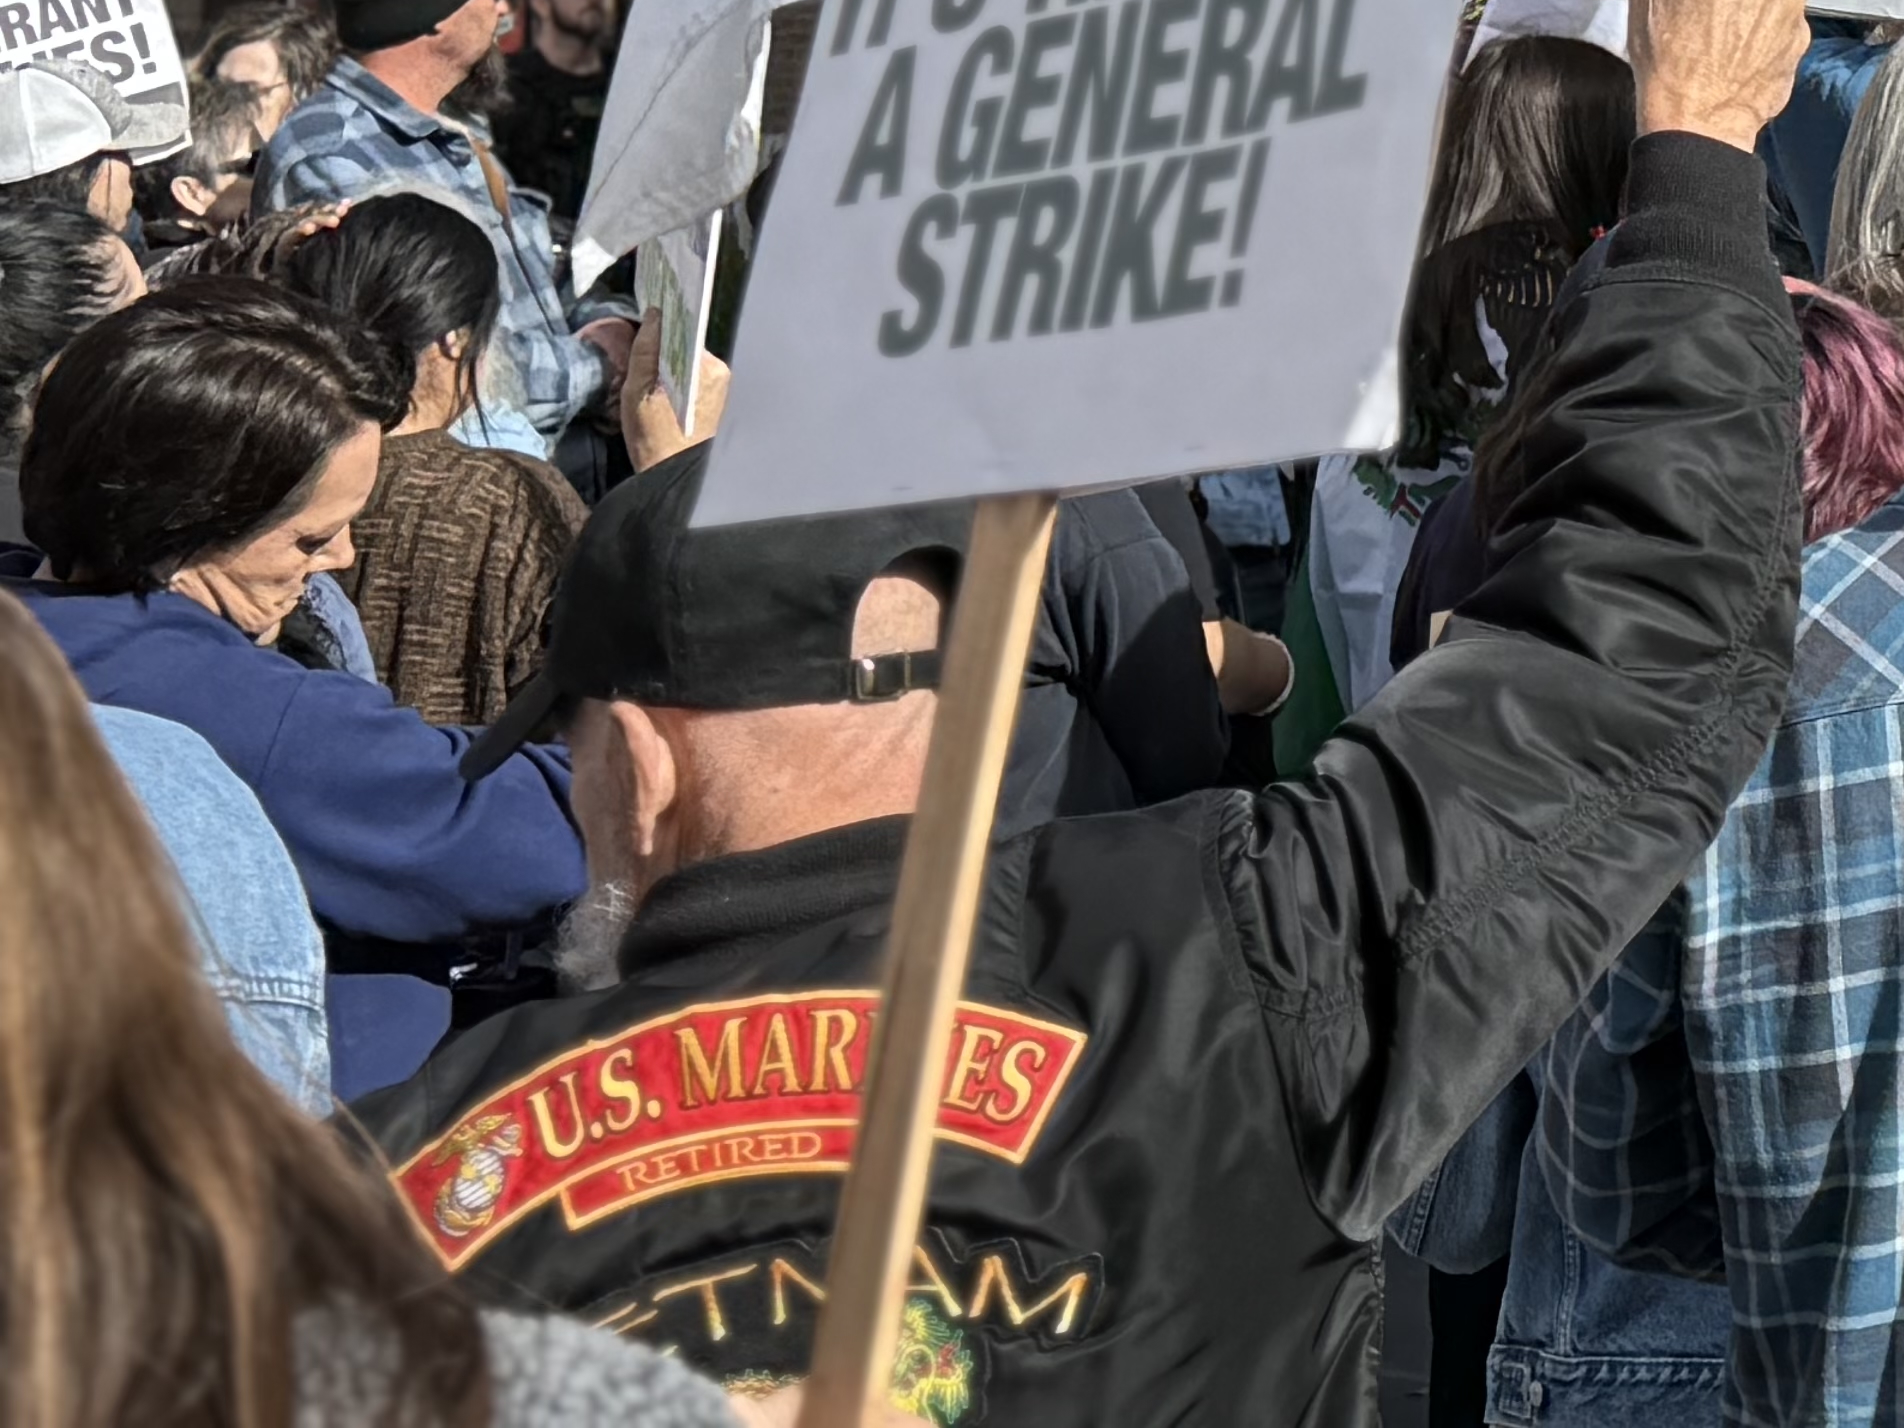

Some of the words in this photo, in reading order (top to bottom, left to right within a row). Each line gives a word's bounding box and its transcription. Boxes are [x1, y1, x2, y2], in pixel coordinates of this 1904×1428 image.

[834, 46, 917, 207] A
[876, 135, 1273, 360] STRIKE!
[525, 1046, 663, 1159] U.S.
[674, 1006, 1050, 1122] MARES
[615, 1128, 824, 1194] RETIRED
